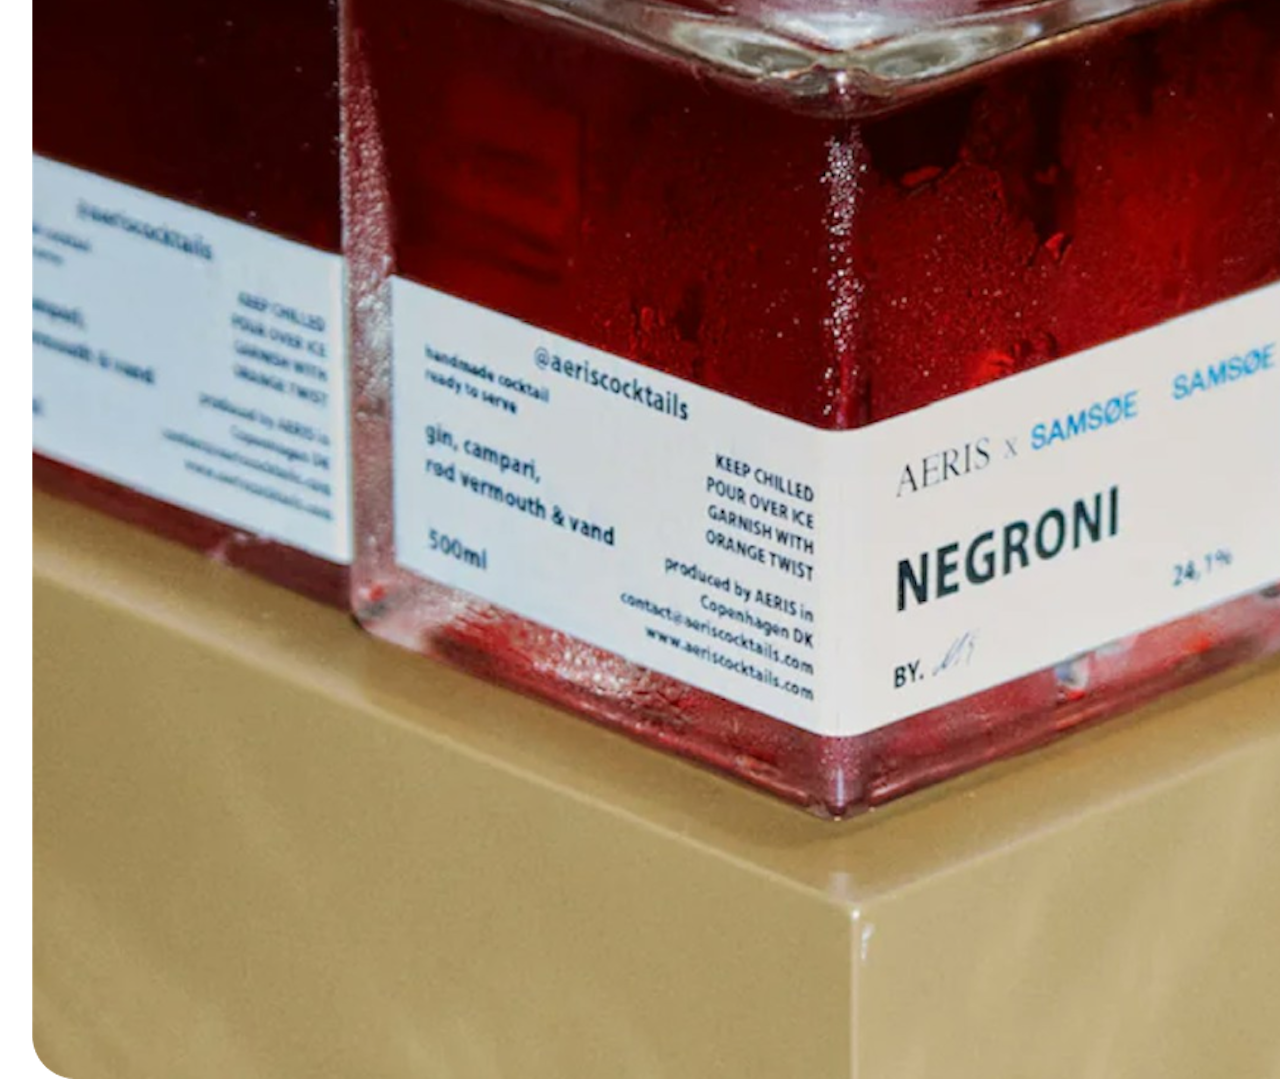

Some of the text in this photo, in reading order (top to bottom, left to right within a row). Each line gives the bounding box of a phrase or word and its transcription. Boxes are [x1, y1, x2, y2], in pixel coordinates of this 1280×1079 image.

[424, 344, 550, 403] handmade cocktail
[425, 368, 462, 395] ready
[481, 389, 518, 414] serve
[534, 346, 689, 421] @aeriscocktails
[896, 342, 1277, 498] AERIS x SAMSØE SAMSØE
[425, 423, 542, 484] gin, campari,
[715, 453, 814, 502] KEEP CHILLED
[460, 468, 548, 520] vermouth
[551, 504, 566, 527] &
[568, 514, 615, 546] vand
[706, 475, 814, 530] POUR OVER ICE
[707, 503, 815, 555] GARNISH WITH
[428, 527, 488, 571] 500ml
[706, 529, 814, 582] ORANGE TWIST
[896, 485, 1120, 612] NEGRONI
[664, 557, 814, 622] produced by AERIS in
[619, 591, 814, 675] contact@aeriscocktails.com
[700, 593, 814, 649] Copenhagen DK
[644, 625, 814, 701] www.aeriscocktails.com
[893, 657, 925, 689] BY.
